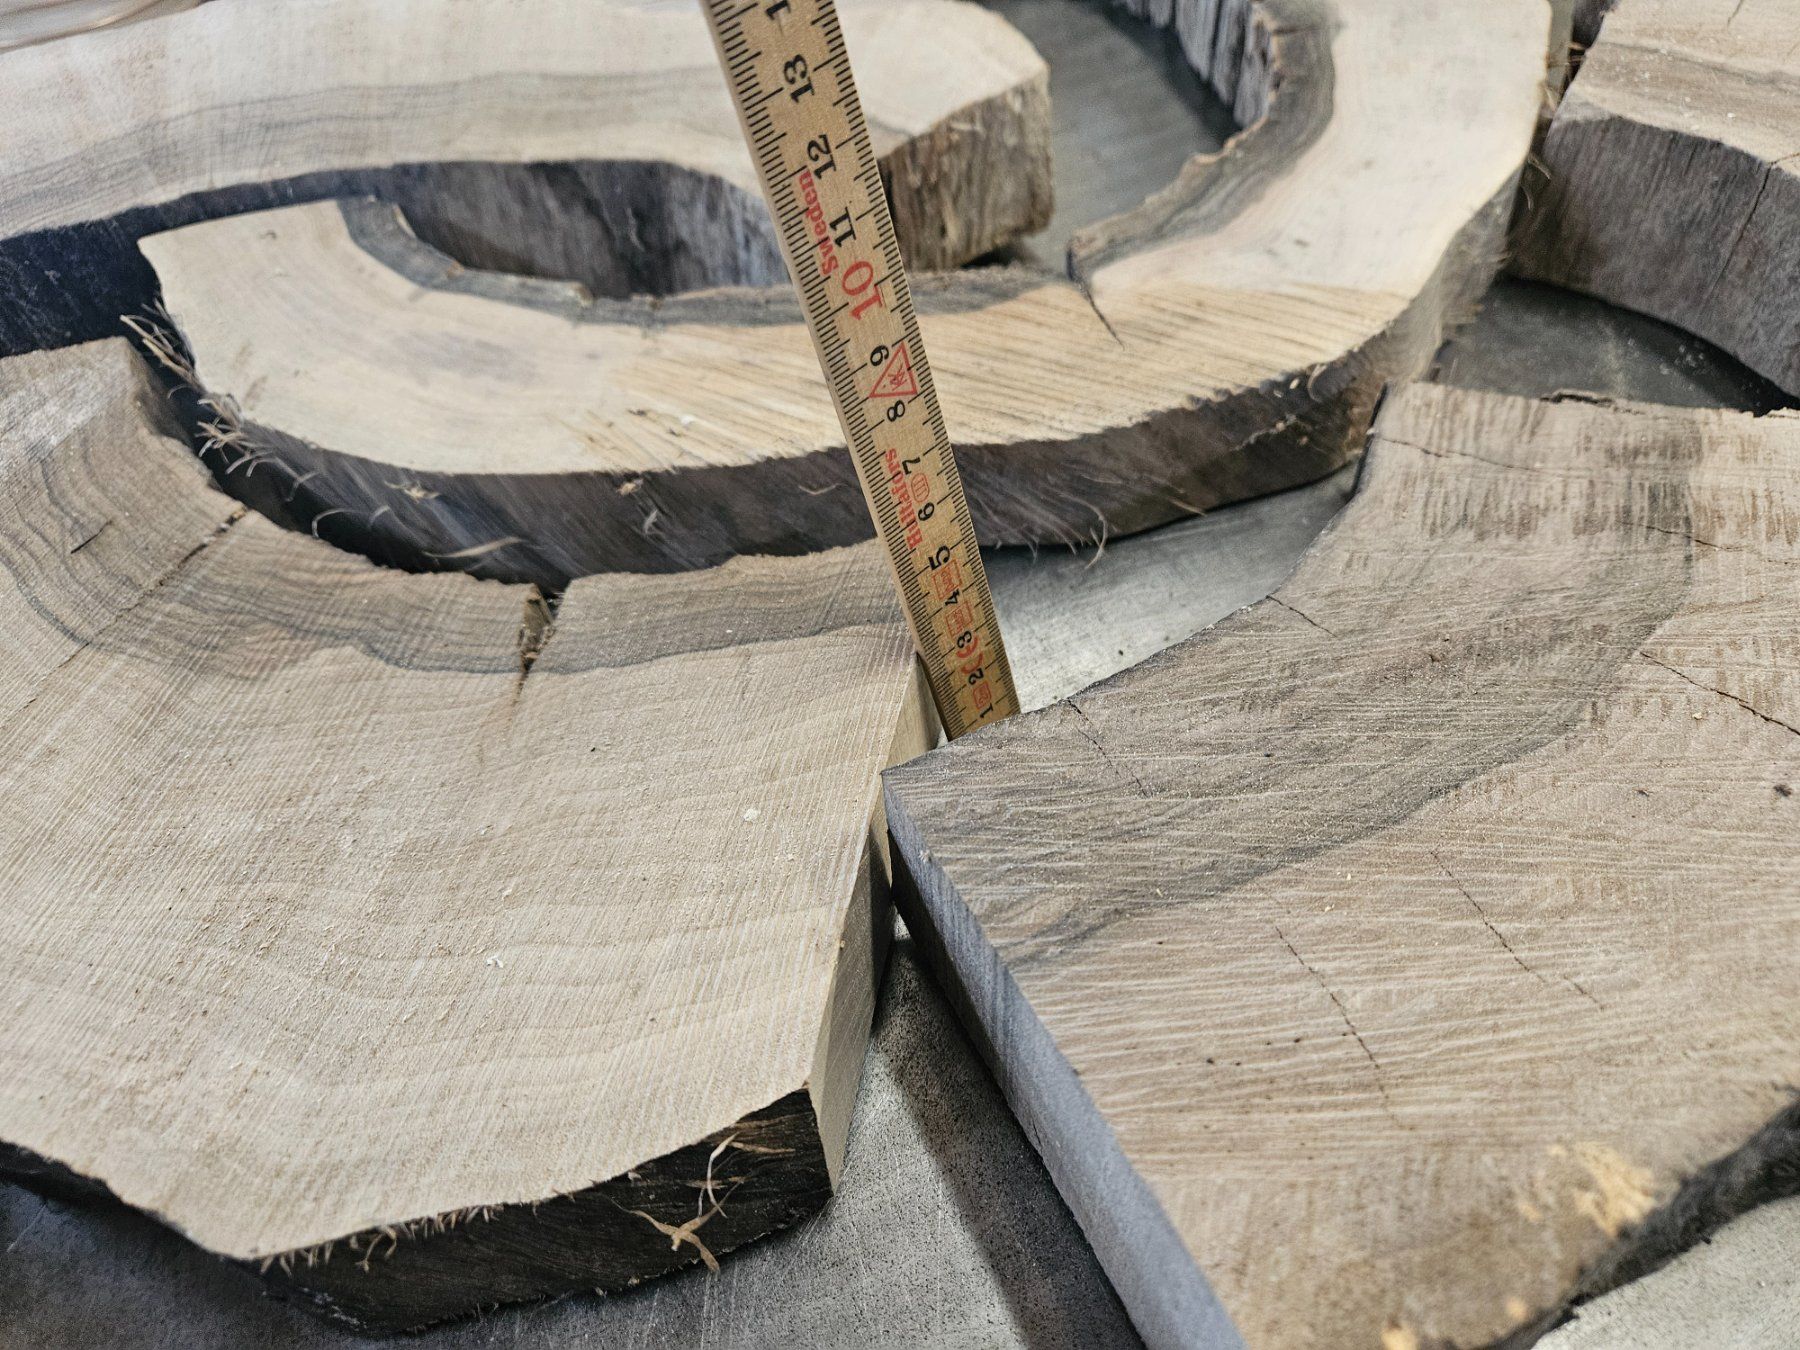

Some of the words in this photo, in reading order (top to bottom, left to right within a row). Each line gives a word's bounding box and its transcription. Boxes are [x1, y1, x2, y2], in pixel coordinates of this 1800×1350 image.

[765, 0, 792, 21] 1
[783, 54, 815, 103] 13
[806, 134, 837, 179] 12
[798, 169, 839, 276] Sweden
[829, 206, 857, 248] 11
[842, 260, 883, 320] 10
[870, 345, 890, 367] 9
[887, 400, 906, 422] 8
[902, 457, 921, 475] 7
[885, 448, 923, 550] Hultafors
[918, 502, 935, 522] 6
[928, 545, 951, 571] 5
[945, 589, 961, 606] 4
[956, 630, 972, 649] 3
[968, 667, 985, 685] 2
[979, 703, 994, 719] 1
